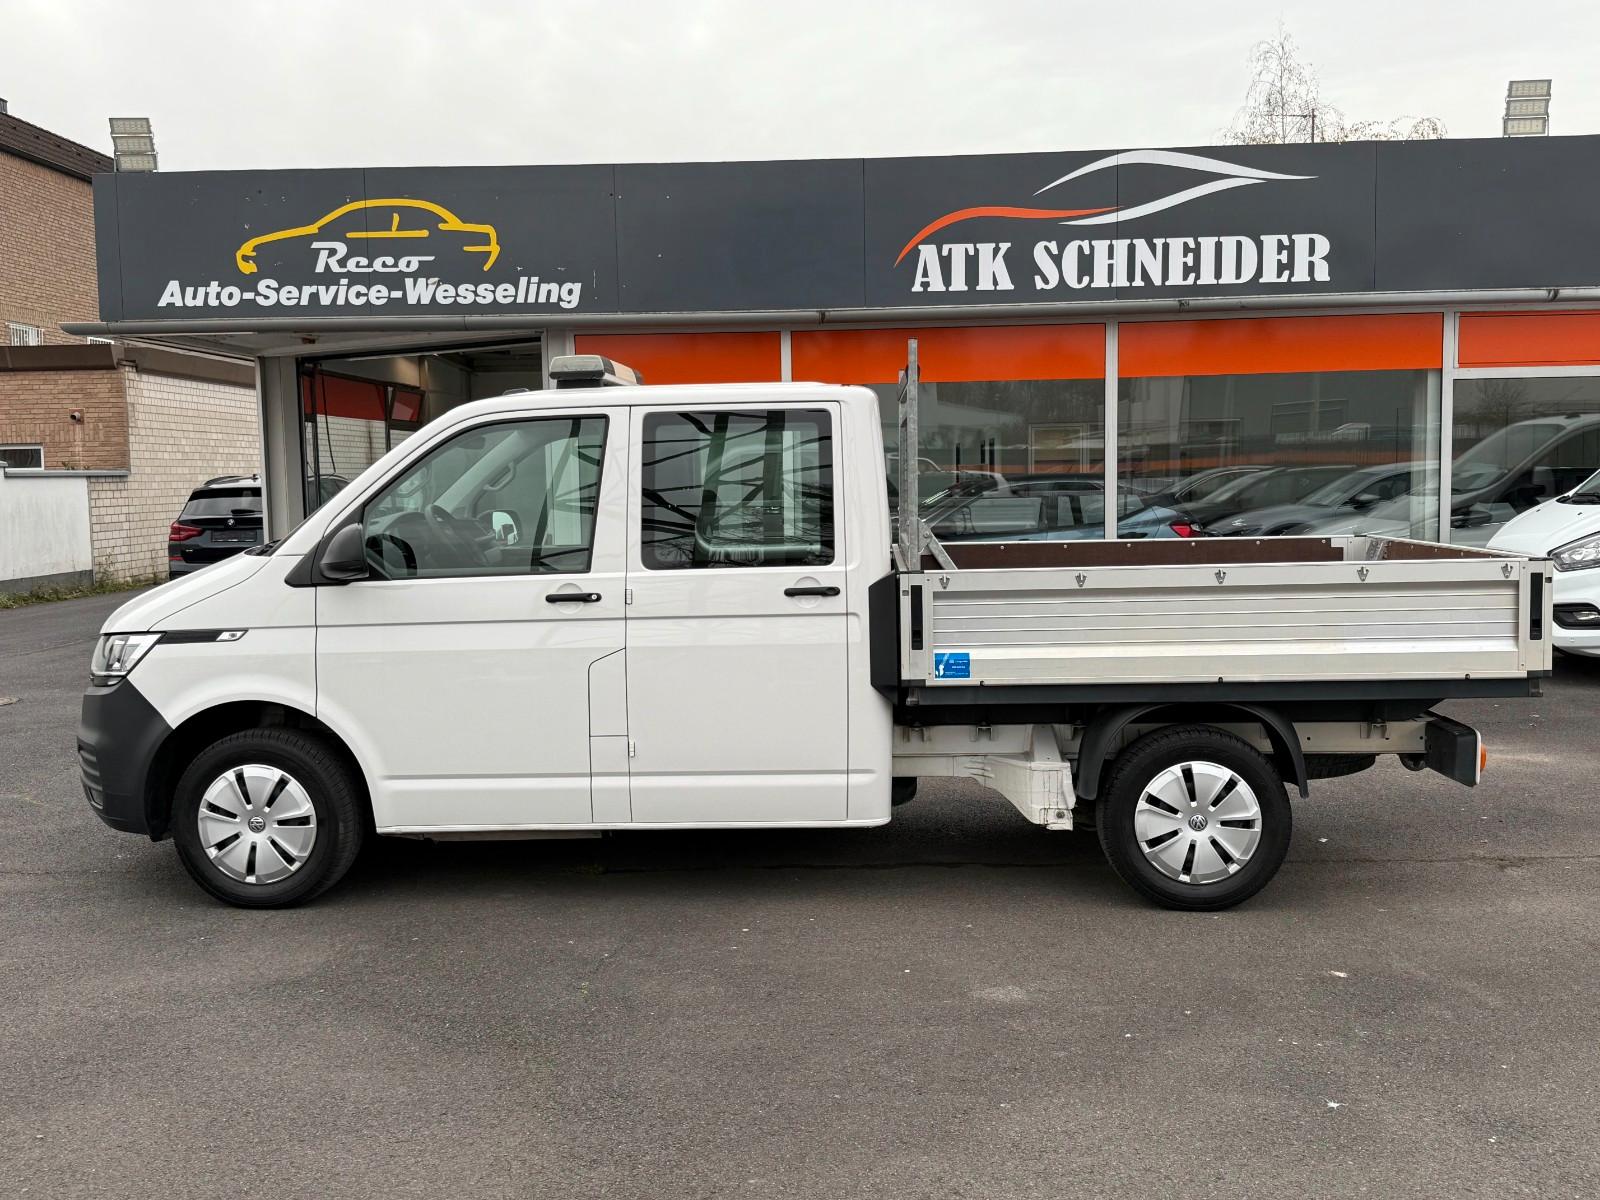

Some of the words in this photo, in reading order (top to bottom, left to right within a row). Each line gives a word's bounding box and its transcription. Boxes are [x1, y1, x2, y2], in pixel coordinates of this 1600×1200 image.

[911, 242, 1014, 292] ATK
[1034, 233, 1331, 290] SCHNEIDER
[157, 276, 582, 309] Auto-Service-Wesseling
